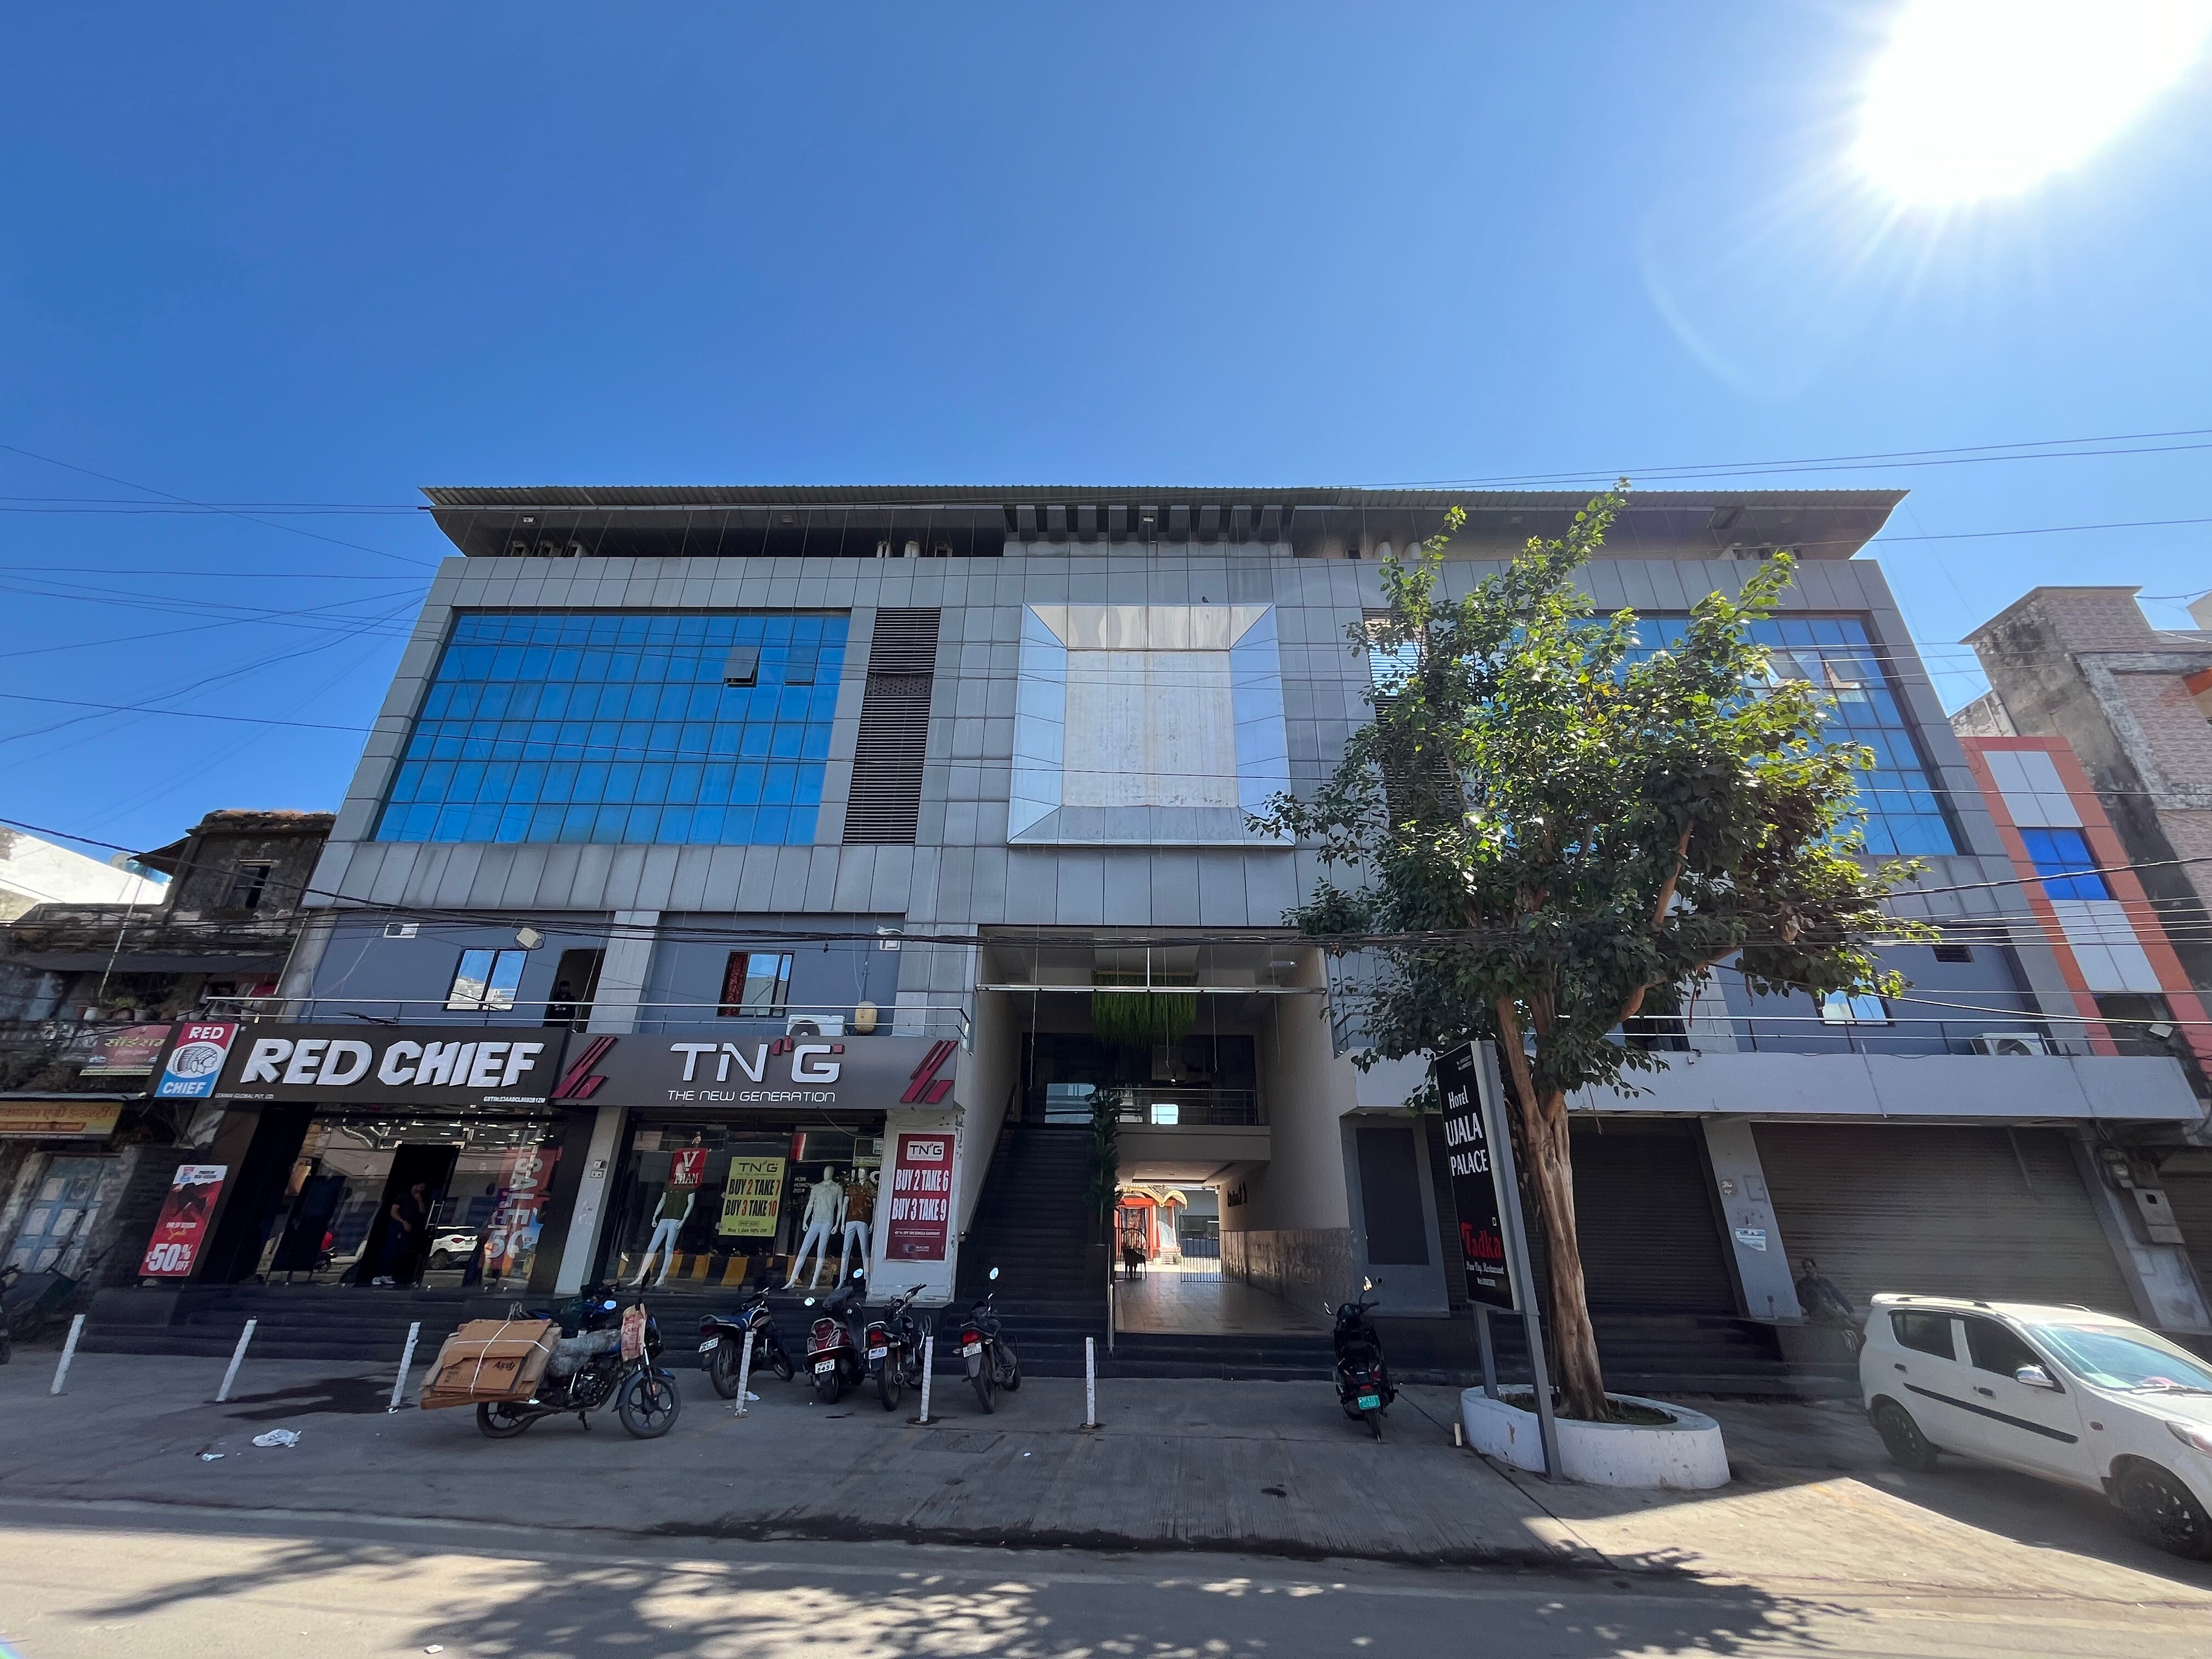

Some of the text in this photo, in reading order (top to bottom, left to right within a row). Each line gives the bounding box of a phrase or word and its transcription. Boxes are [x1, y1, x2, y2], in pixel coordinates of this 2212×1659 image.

[188, 1026, 225, 1039] RED
[240, 1038, 545, 1087] RED CHIEF
[162, 1081, 207, 1094] CHIEF
[668, 1090, 836, 1102] THE NEW GENERATION
[1445, 1112, 1483, 1147] UJALA
[1450, 1149, 1488, 1176] PALACE
[728, 1178, 781, 1195] BUY 2 TAKE 7
[895, 1169, 949, 1192] BUY 2 TAKE 6
[500, 1158, 543, 1225] SALE
[725, 1199, 777, 1217] BUY 3 TAKE 10
[891, 1198, 947, 1221] BUY 3 TAKE 9
[174, 1261, 190, 1271] OFF
